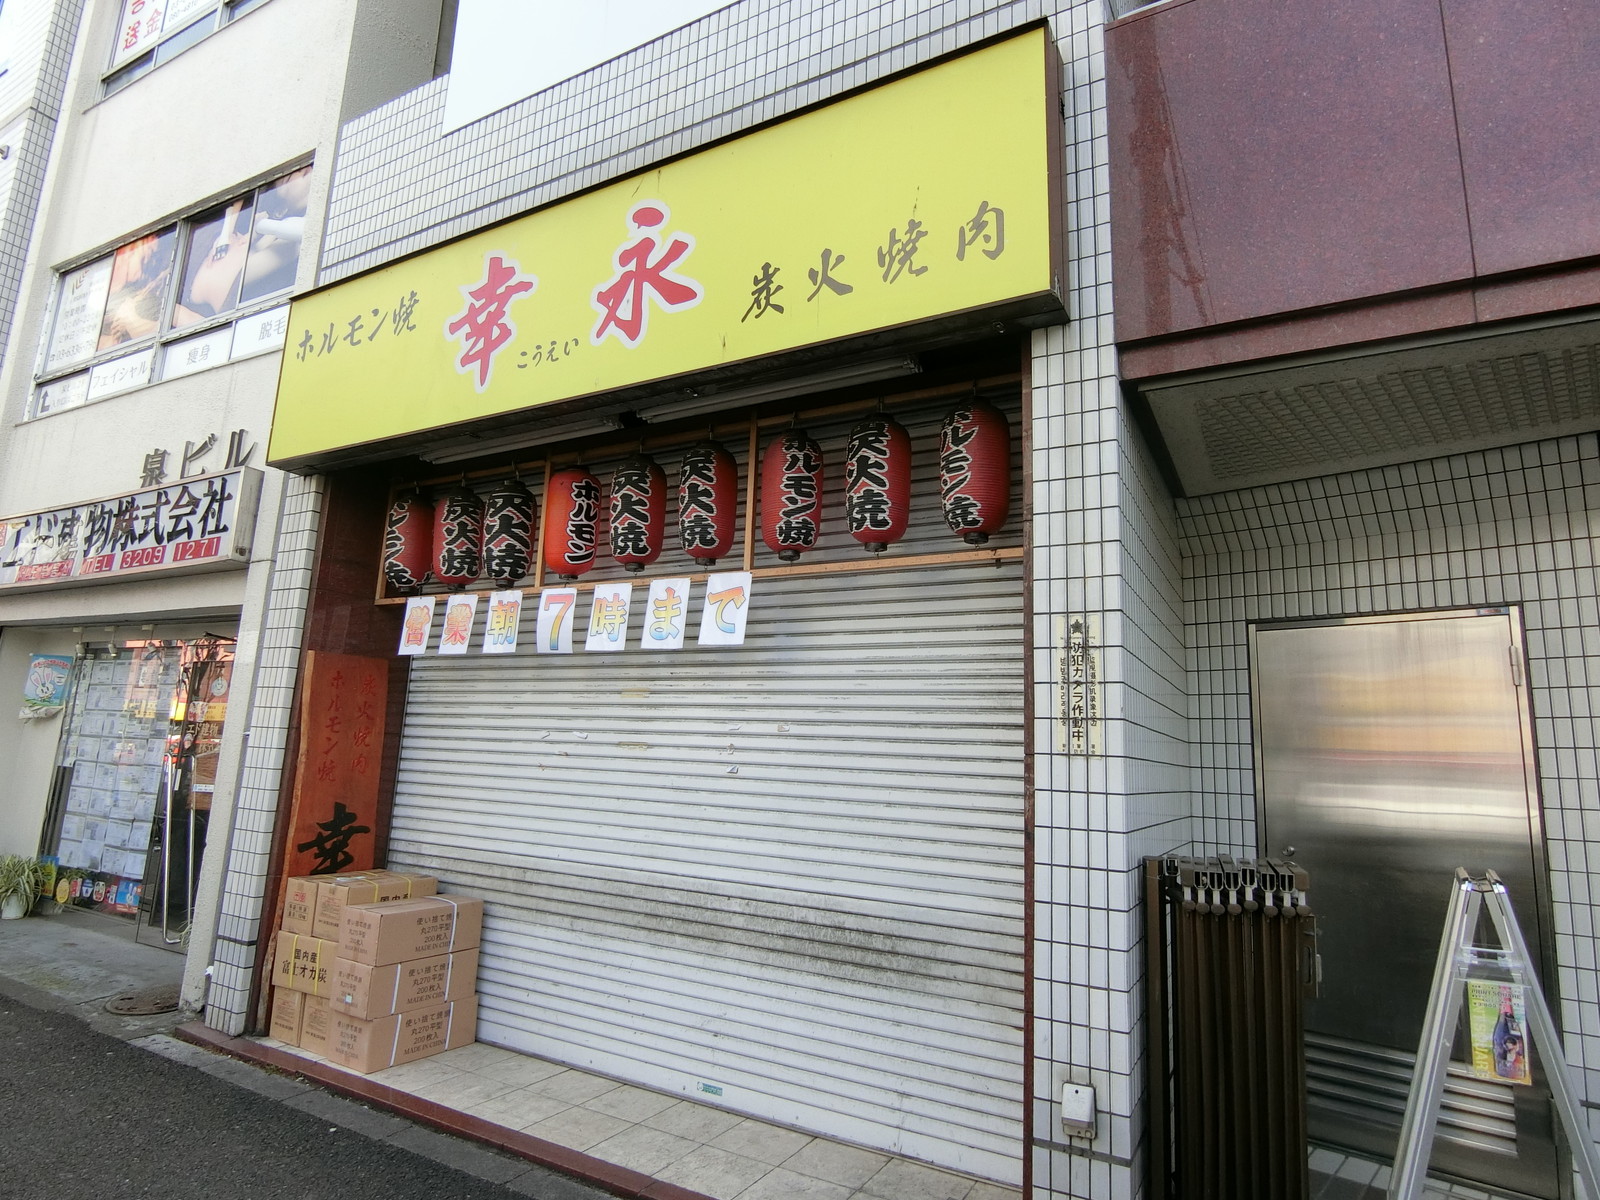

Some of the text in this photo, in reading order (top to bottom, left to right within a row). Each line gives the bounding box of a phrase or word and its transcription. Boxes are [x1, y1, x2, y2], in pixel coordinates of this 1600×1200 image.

[741, 200, 1005, 323] 炭火焼肉
[448, 206, 698, 387] 幸永
[258, 316, 285, 341] 脱毛
[297, 290, 420, 363] ホルモン焼
[93, 361, 148, 389] フェイシャル
[517, 337, 579, 369] こうえい
[140, 429, 258, 488] 泉ビル
[565, 479, 600, 564] ホルモン
[86, 537, 219, 574] TEL 3209 1271
[404, 586, 746, 651] 営業朝7時まで
[1071, 641, 1085, 742] 防犯カメラ作動中
[318, 671, 346, 782] ホルモン焼
[351, 674, 377, 774] 炭火焼肉
[294, 949, 318, 964] 国内産
[424, 933, 449, 943] 200枚入
[416, 983, 441, 994] 200枚入
[404, 1045, 421, 1055] MADE
[413, 1032, 439, 1044] 200枚入
